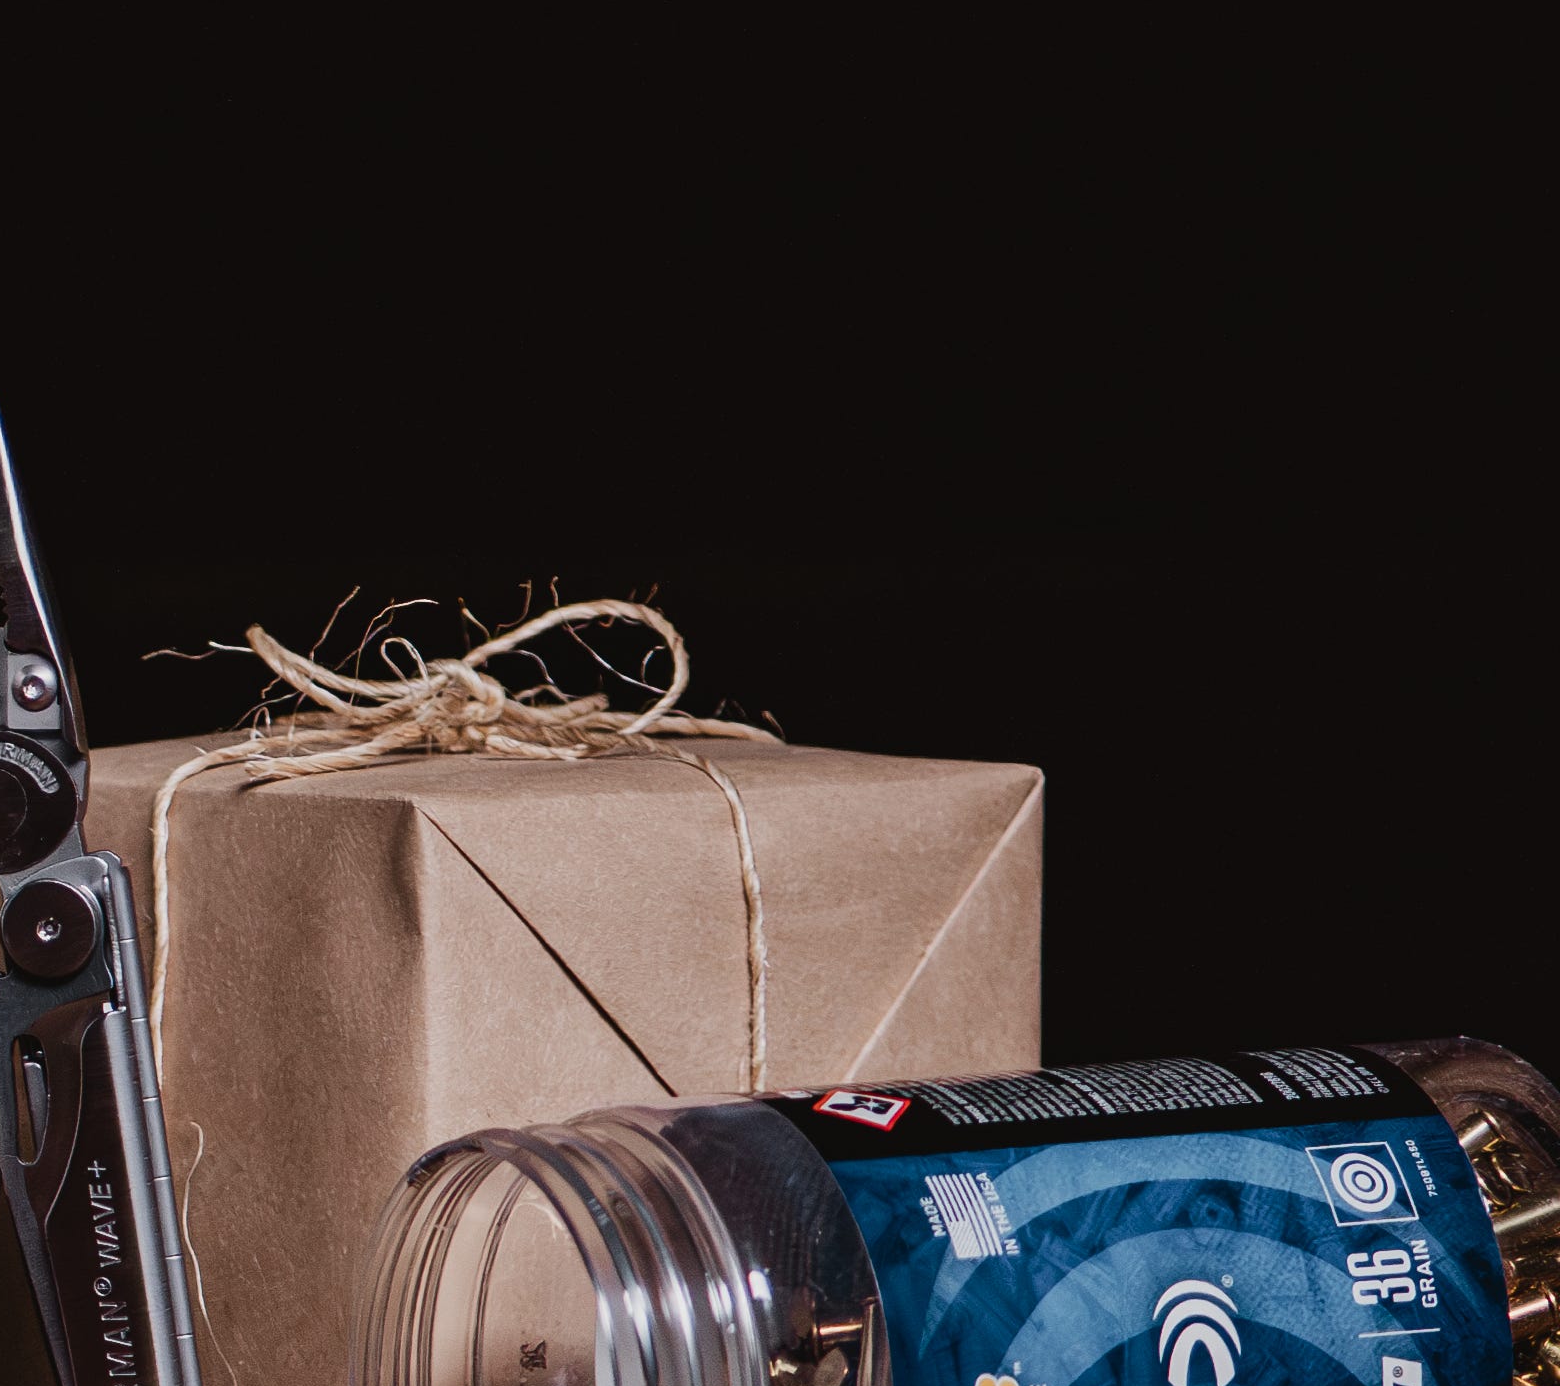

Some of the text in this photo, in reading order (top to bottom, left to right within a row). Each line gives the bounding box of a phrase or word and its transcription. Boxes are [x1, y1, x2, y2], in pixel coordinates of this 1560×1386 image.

[87, 1160, 122, 1268] WAVE+
[920, 1196, 946, 1237] MADE
[976, 1173, 1020, 1254] IN THE USA
[1347, 1248, 1416, 1305] 36
[1409, 1239, 1439, 1310] GRAIN
